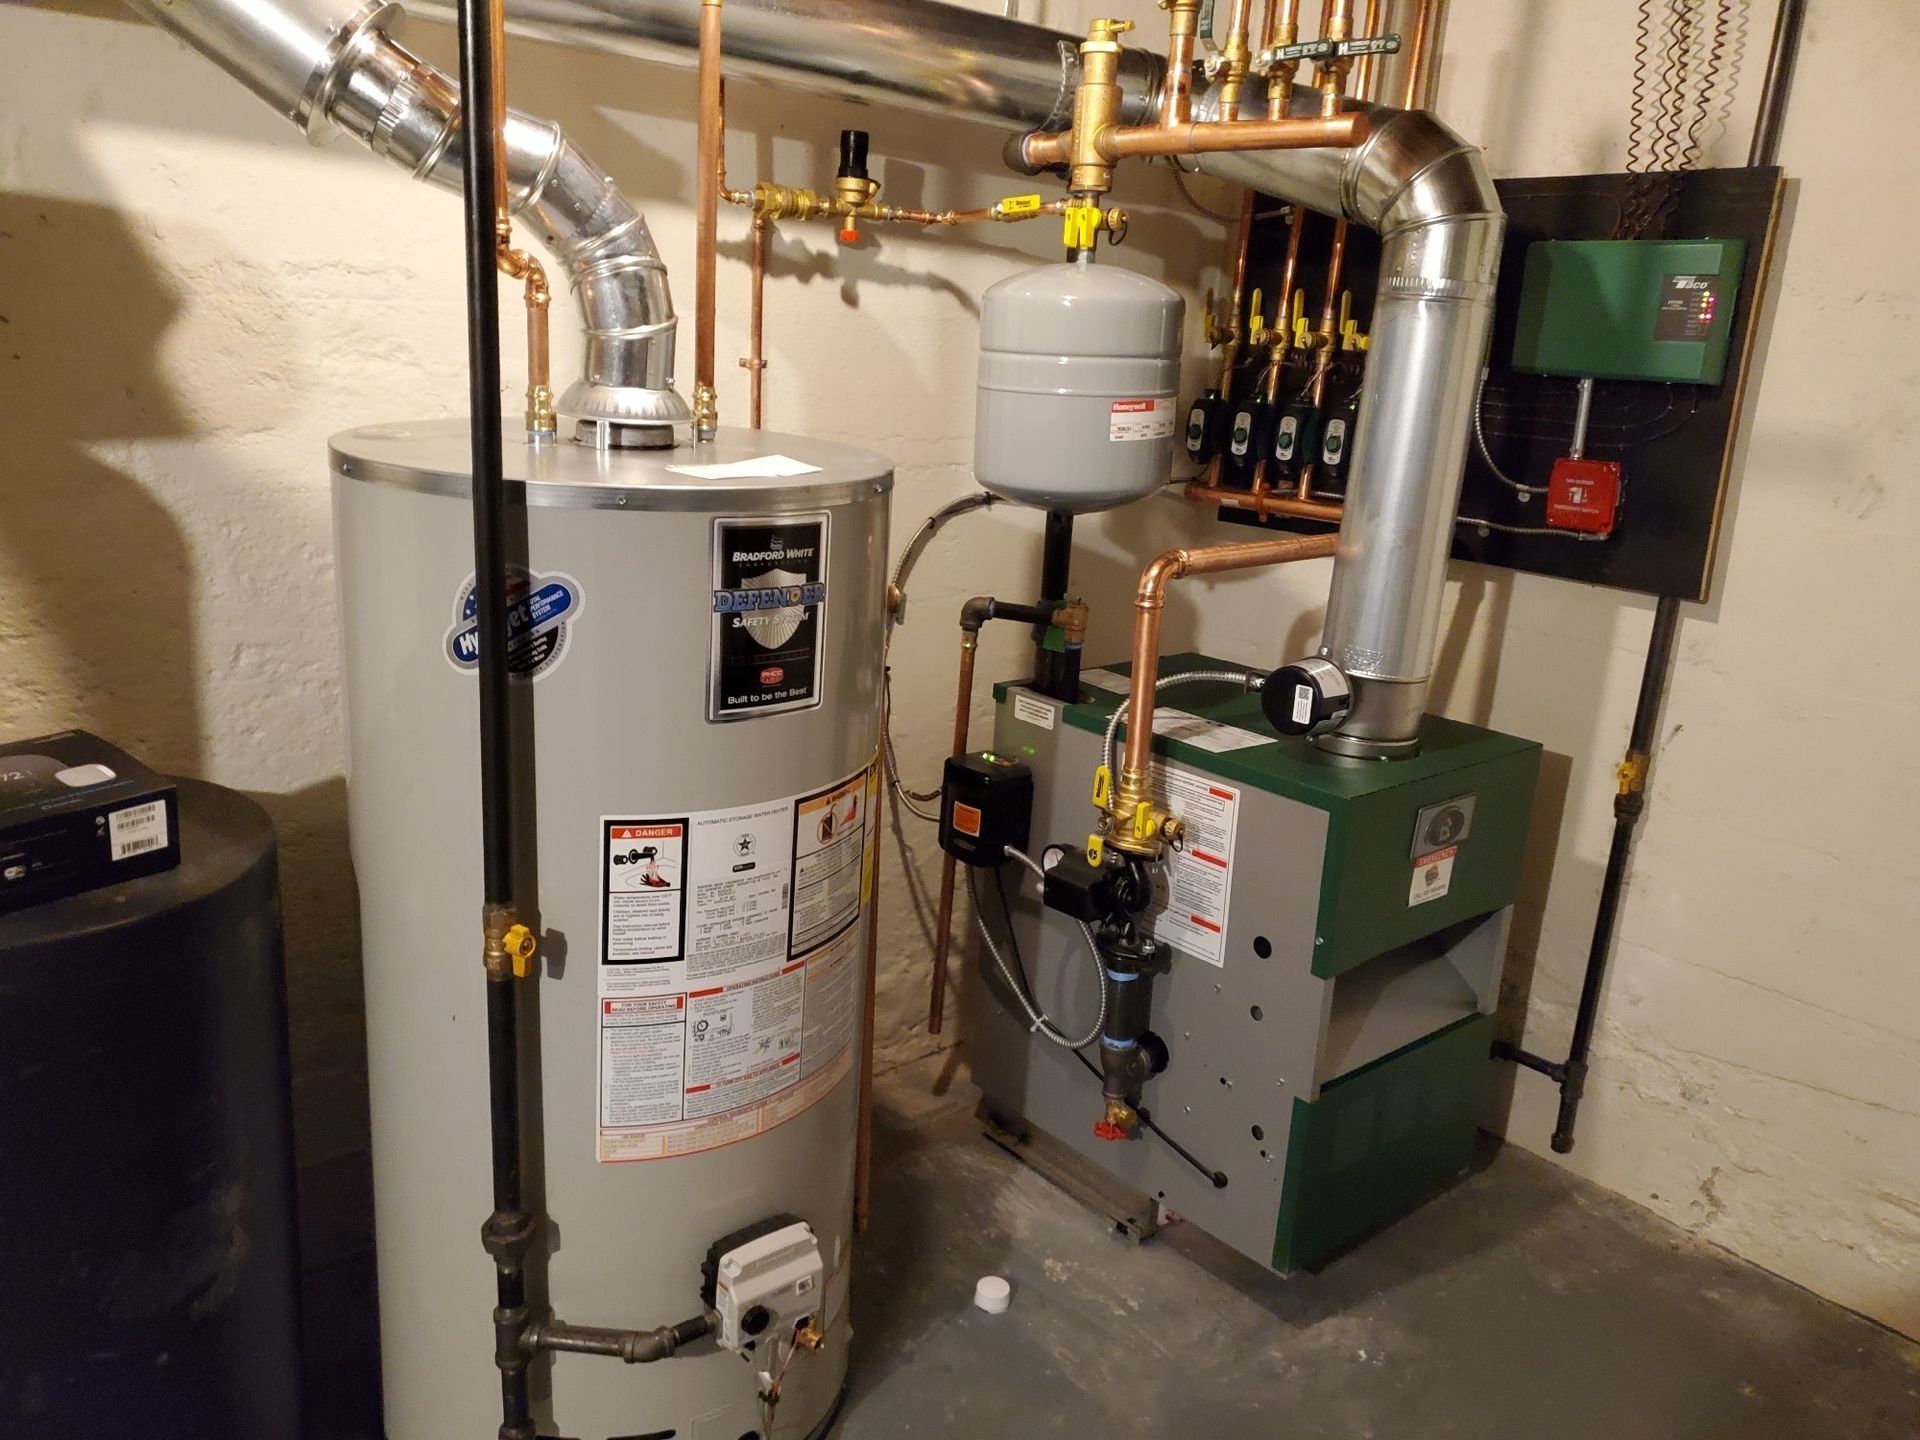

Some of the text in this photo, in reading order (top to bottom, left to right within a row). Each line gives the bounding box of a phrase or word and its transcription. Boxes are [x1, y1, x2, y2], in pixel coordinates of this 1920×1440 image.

[1672, 276, 1708, 289] Taco
[1113, 402, 1146, 411] Honeywell
[732, 547, 815, 562] BRADFORD WHITE
[713, 582, 826, 613] DEFENDER
[732, 614, 770, 628] SAFETY
[727, 687, 807, 705] Built to be the Best
[697, 818, 728, 826] AUTOMATIC
[729, 814, 752, 822] STORAGE
[754, 811, 770, 819] WATER
[635, 828, 673, 837] DANGER
